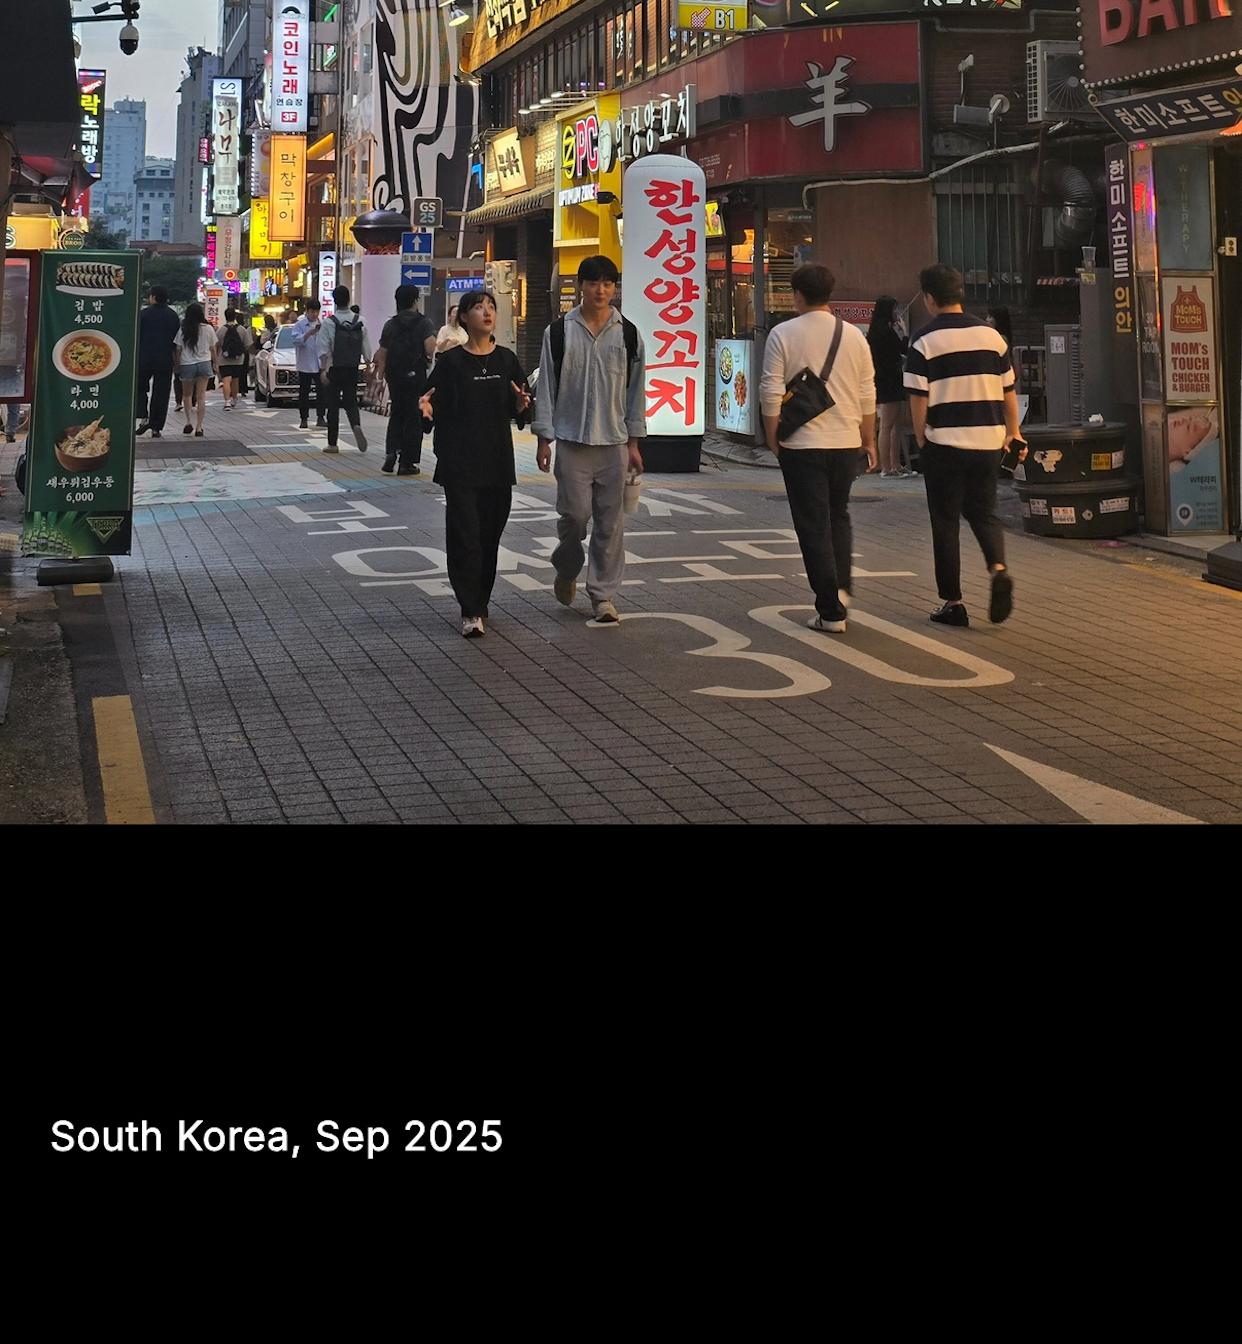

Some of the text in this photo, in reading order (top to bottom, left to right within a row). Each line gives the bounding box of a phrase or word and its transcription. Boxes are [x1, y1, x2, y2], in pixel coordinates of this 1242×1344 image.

[714, 9, 735, 29] B1
[282, 22, 299, 94] 코인노래
[276, 98, 303, 106] 연습장
[788, 55, 873, 154] 羊
[282, 112, 296, 122] 3F
[1114, 93, 1234, 134] 한미소프트
[576, 114, 599, 178] PC
[279, 153, 297, 223] 막창구이
[419, 202, 436, 212] GS
[419, 212, 436, 223] 25
[1109, 159, 1133, 334] 한미 소프트 의안
[449, 279, 473, 289] ATM
[644, 179, 700, 427] 한성양꼬치
[74, 314, 103, 325] 4,500
[1143, 326, 1157, 337] TAP
[1171, 357, 1210, 371] TOUCH
[1172, 372, 1210, 383] CHICKEN
[1172, 383, 1211, 393] & BURGER
[70, 399, 99, 411] 4,000
[45, 475, 115, 489] 새우튀김우동
[66, 492, 94, 504] 6,000
[585, 604, 1016, 699] 30
